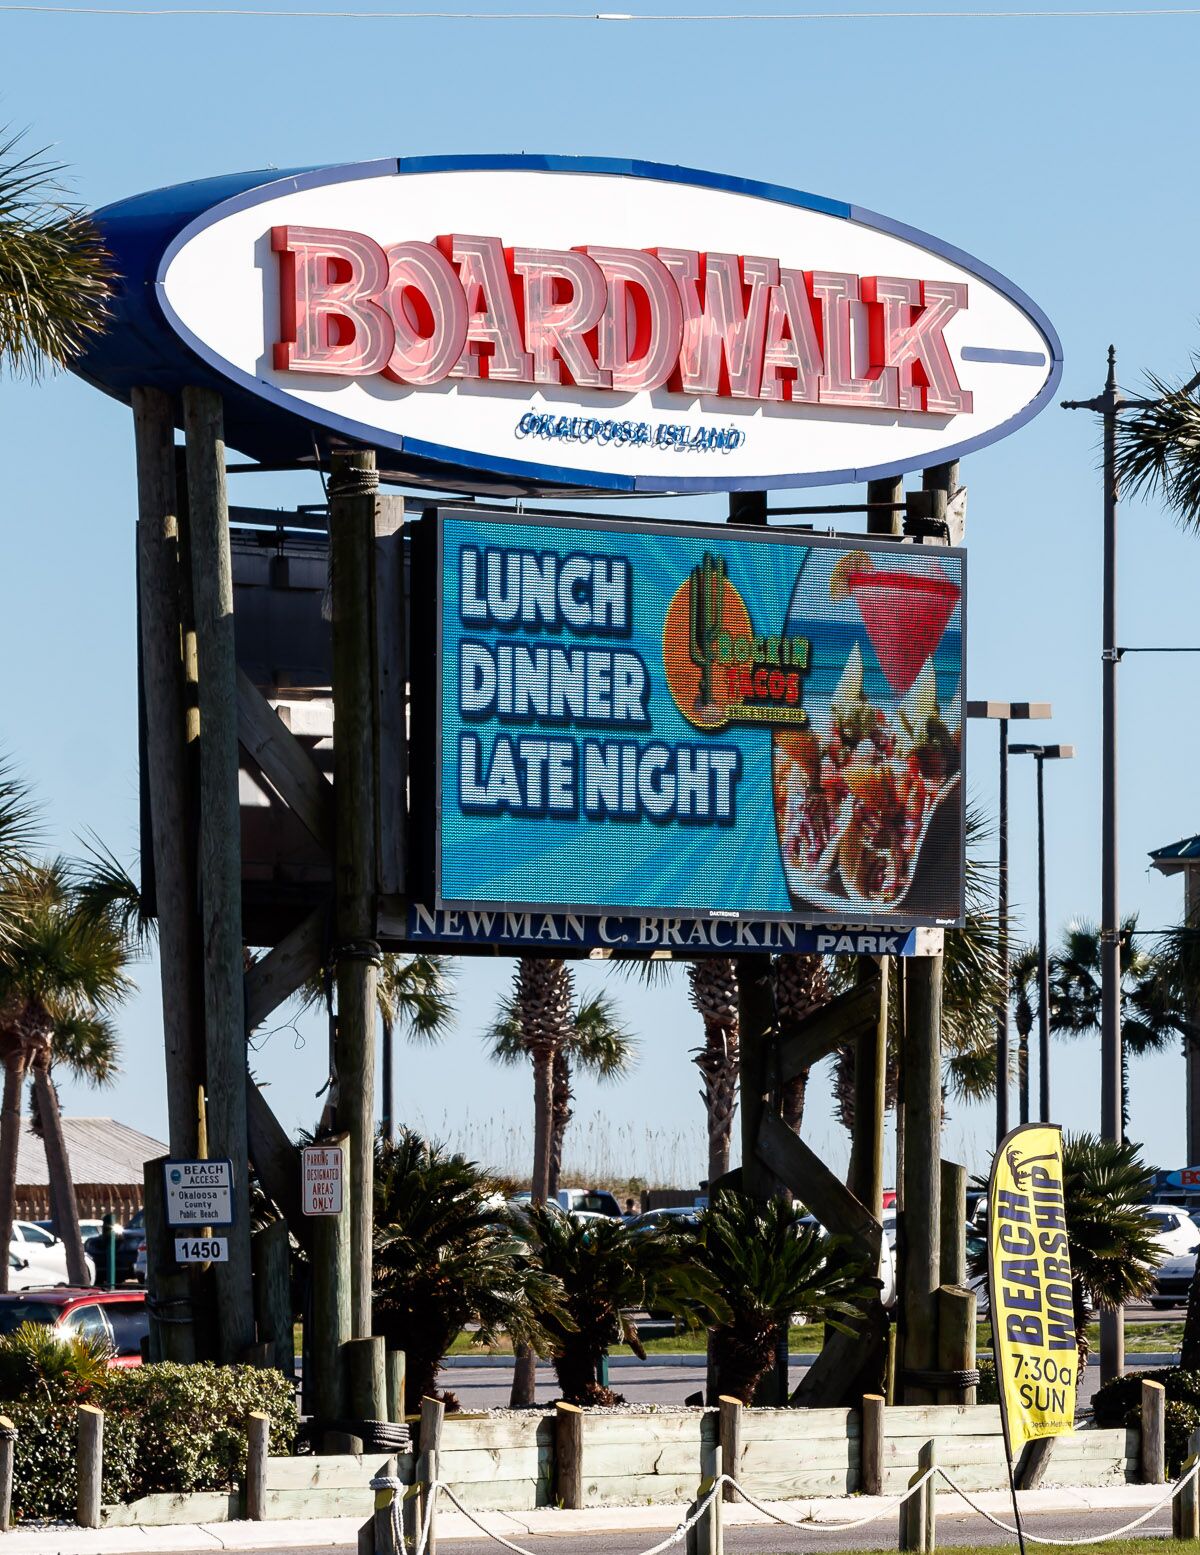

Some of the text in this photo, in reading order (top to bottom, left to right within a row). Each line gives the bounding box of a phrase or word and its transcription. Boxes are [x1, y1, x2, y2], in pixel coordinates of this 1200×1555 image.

[272, 224, 973, 414] BOARDWALK
[516, 411, 744, 453] OKALOOSA ISLAND
[460, 549, 629, 629] LUNCH
[459, 642, 648, 722] DINNER
[726, 666, 799, 703] TACOS
[459, 736, 738, 816] LATE NIGHT
[413, 903, 797, 948] NEWMAN C. BRACKIN
[817, 934, 899, 953] PARK
[183, 1165, 224, 1175] BEACH
[306, 1154, 339, 1166] PARKING IN
[189, 1175, 220, 1184] ACCESS
[306, 1168, 339, 1181] DESIGNATED
[178, 1190, 218, 1200] Okaloosa
[312, 1183, 334, 1195] AREAS
[179, 1209, 219, 1219] Public Beach
[184, 1201, 212, 1209] County
[312, 1197, 334, 1210] ONLY
[181, 1241, 221, 1259] 1450
[1031, 1165, 1076, 1351] WORSHIP
[998, 1189, 1044, 1347] BEACH
[1012, 1353, 1072, 1386] 7:30a
[1020, 1383, 1066, 1414] SUN
